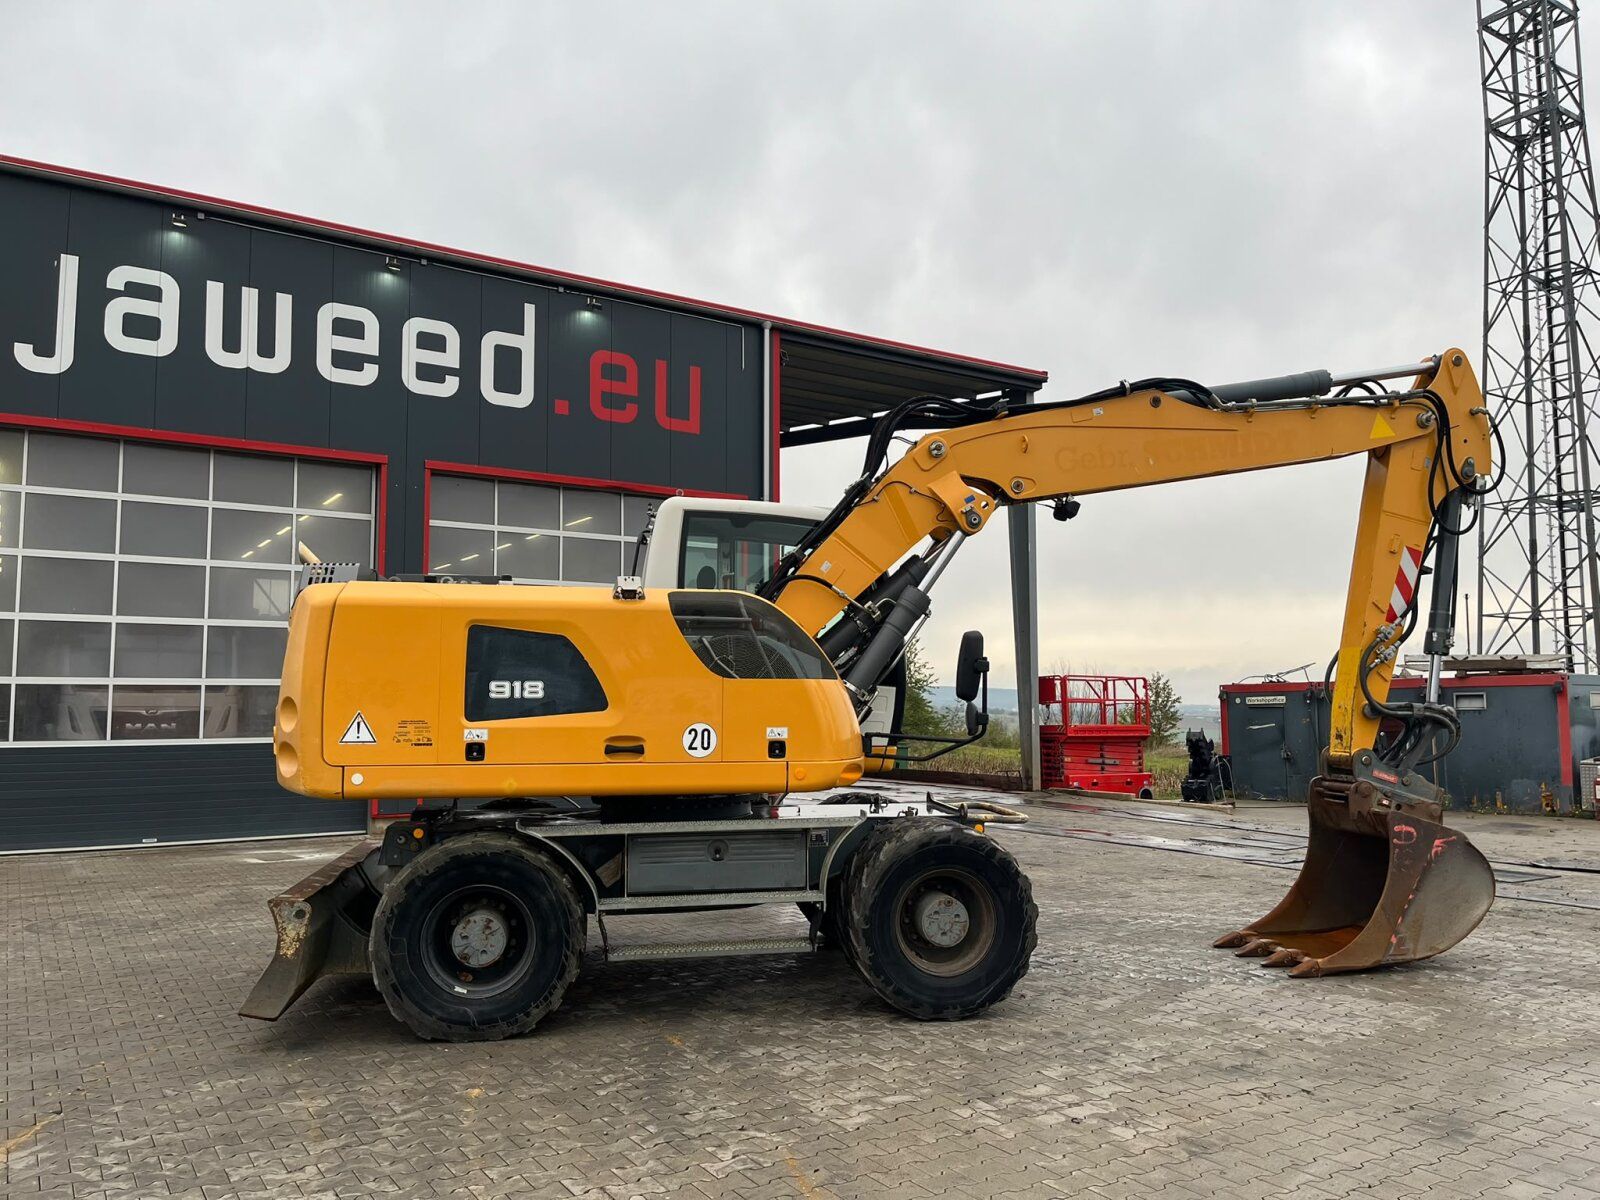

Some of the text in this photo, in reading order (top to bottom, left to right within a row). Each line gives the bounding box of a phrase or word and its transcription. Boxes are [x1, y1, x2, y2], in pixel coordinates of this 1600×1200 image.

[14, 253, 701, 434] jaweed.eu
[488, 680, 545, 699] 918
[125, 722, 177, 730] MAN
[687, 728, 711, 751] 20
